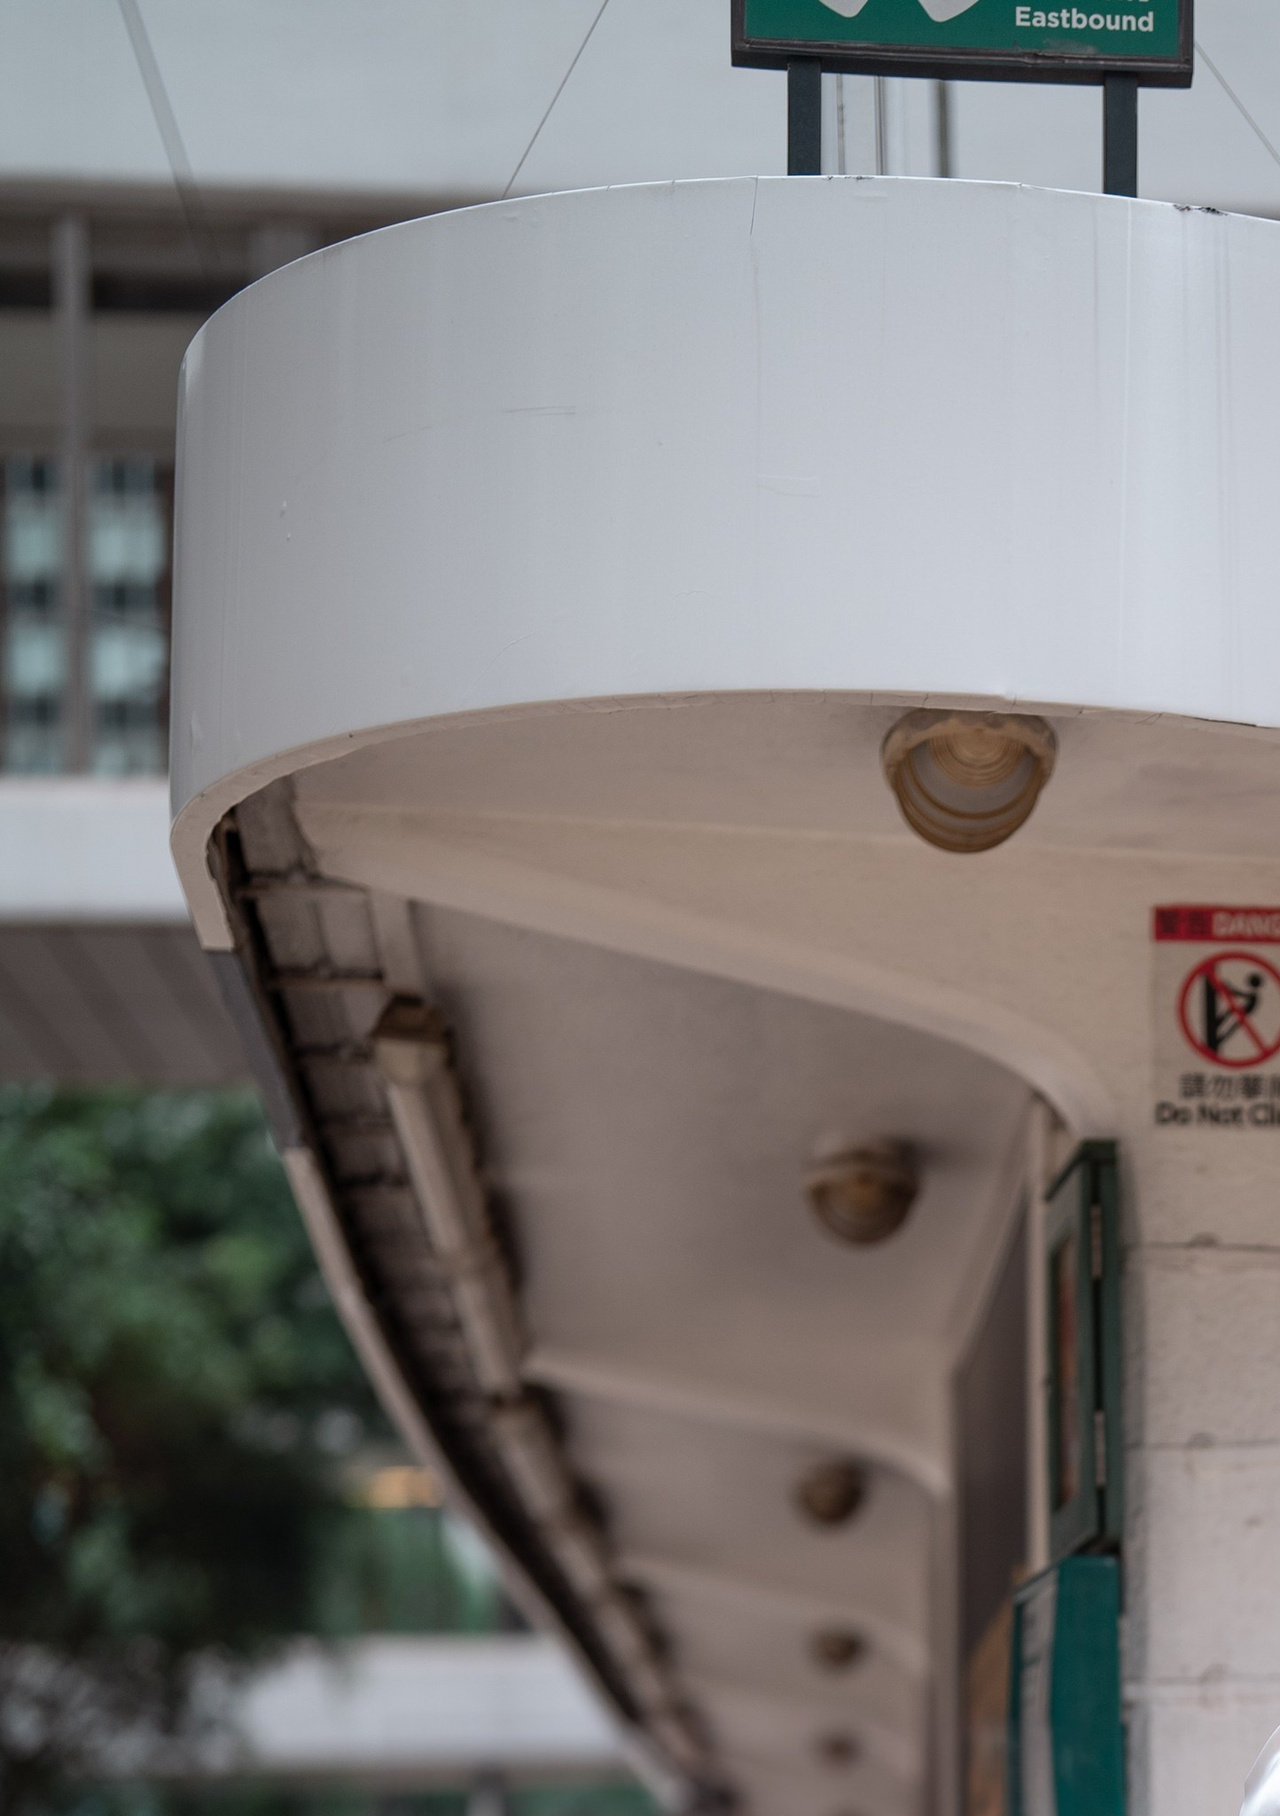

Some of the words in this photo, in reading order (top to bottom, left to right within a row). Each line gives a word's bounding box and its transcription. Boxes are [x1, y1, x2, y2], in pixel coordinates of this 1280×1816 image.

[1015, 6, 1154, 32] Eastbound
[1157, 1102, 1191, 1124] Do
[1198, 1104, 1242, 1125] Not
